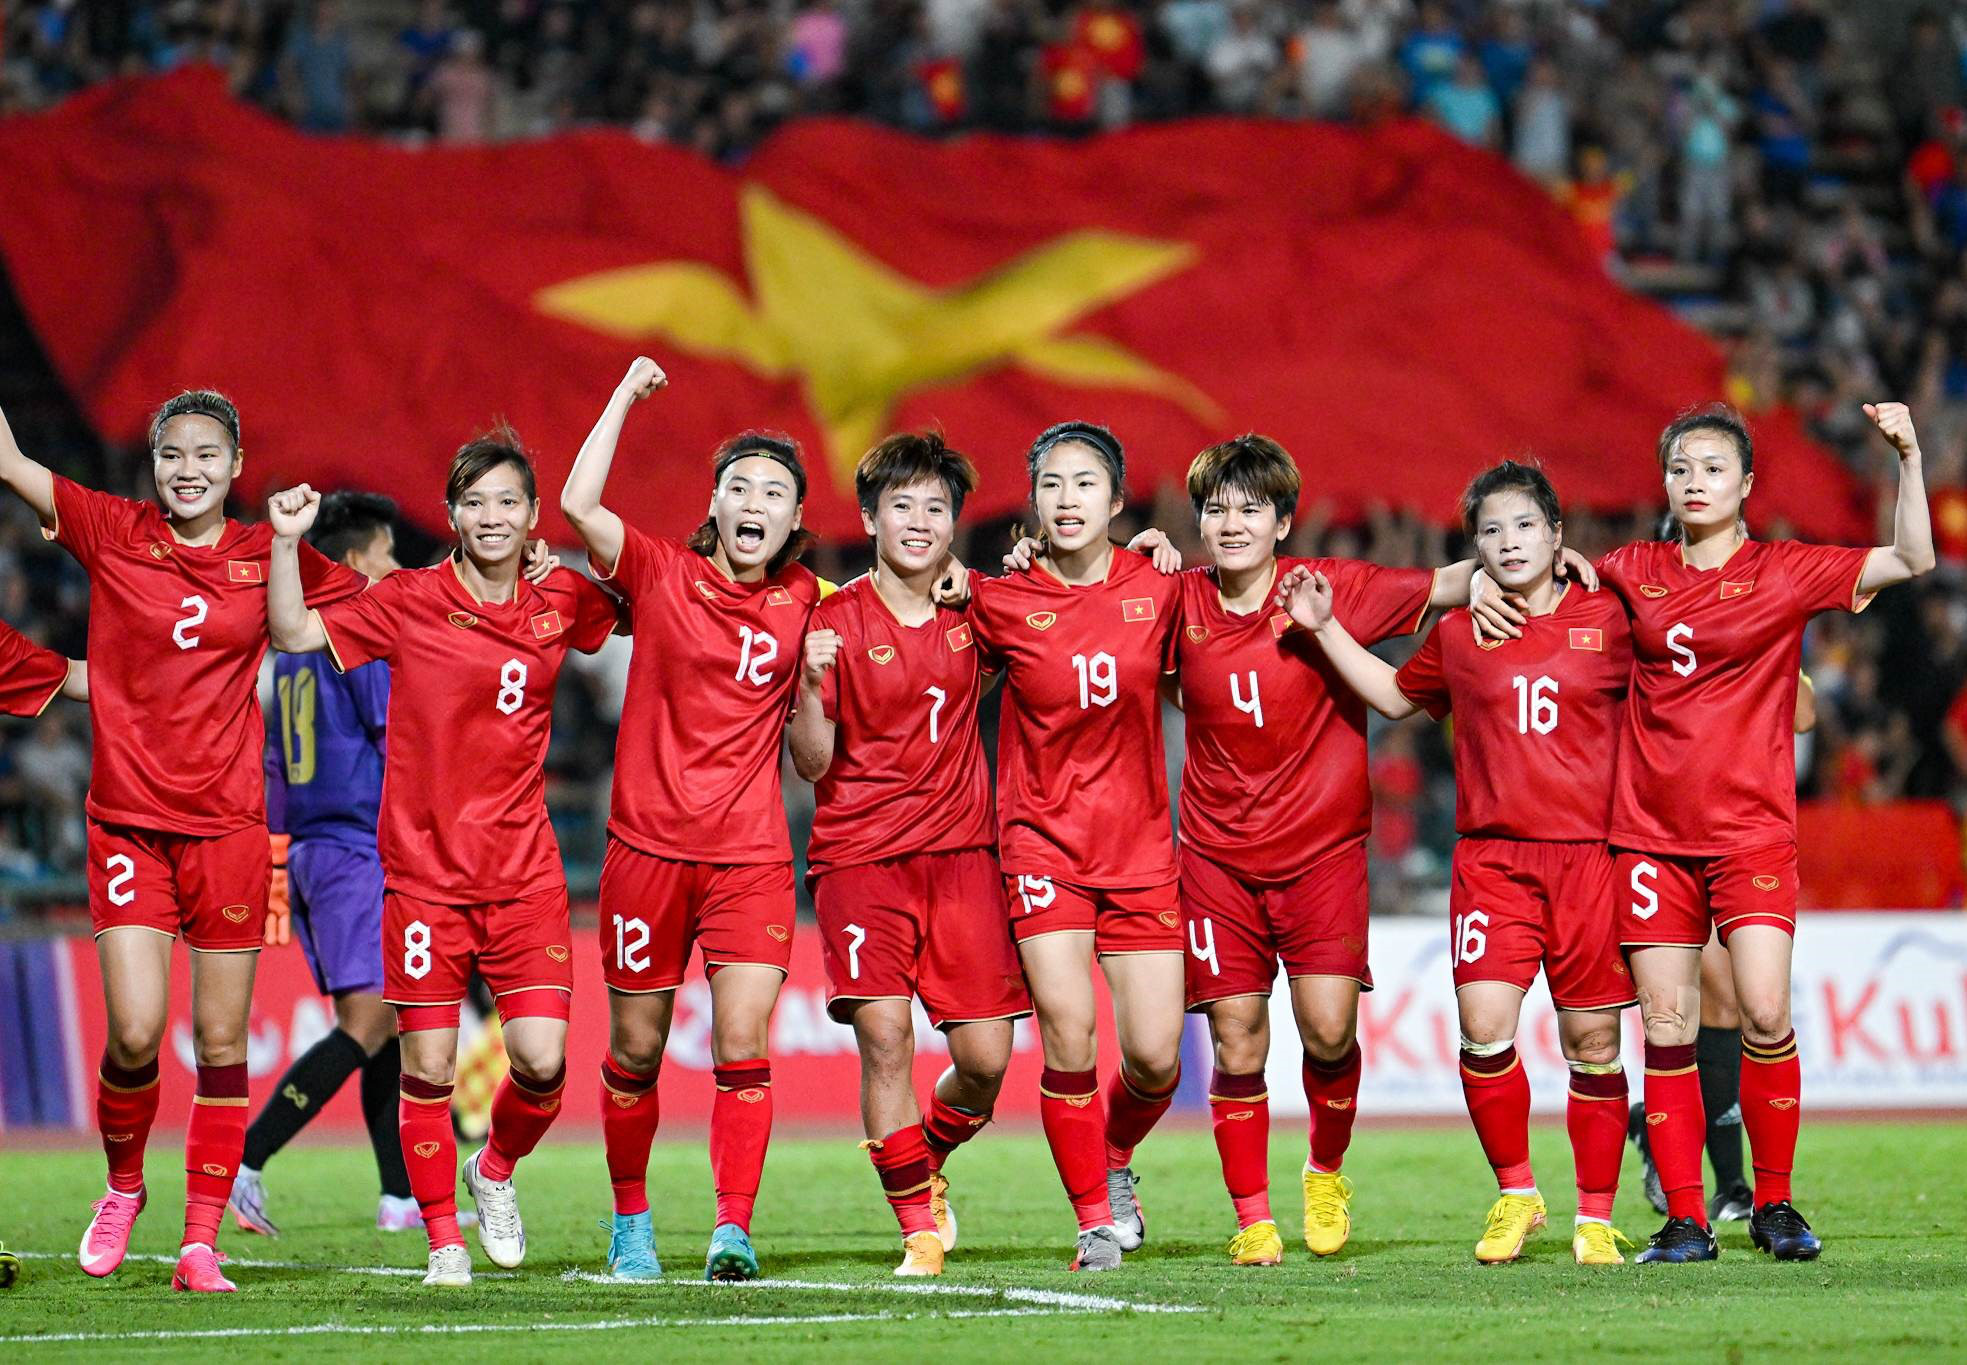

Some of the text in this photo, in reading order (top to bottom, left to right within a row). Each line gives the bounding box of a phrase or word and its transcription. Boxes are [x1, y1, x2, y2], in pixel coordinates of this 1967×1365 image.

[173, 595, 208, 650] 2
[735, 625, 778, 686] 12
[1072, 651, 1117, 710] 19
[496, 658, 527, 715] 8
[924, 685, 945, 743] 7
[1230, 670, 1264, 728] 4
[1512, 675, 1559, 735] 16
[106, 854, 134, 906] 2
[404, 920, 431, 980] 8
[613, 914, 651, 973] 12
[842, 923, 866, 979] 7
[1188, 917, 1220, 976] 4
[1454, 909, 1490, 968] 16
[1818, 970, 1967, 1068] Ku
